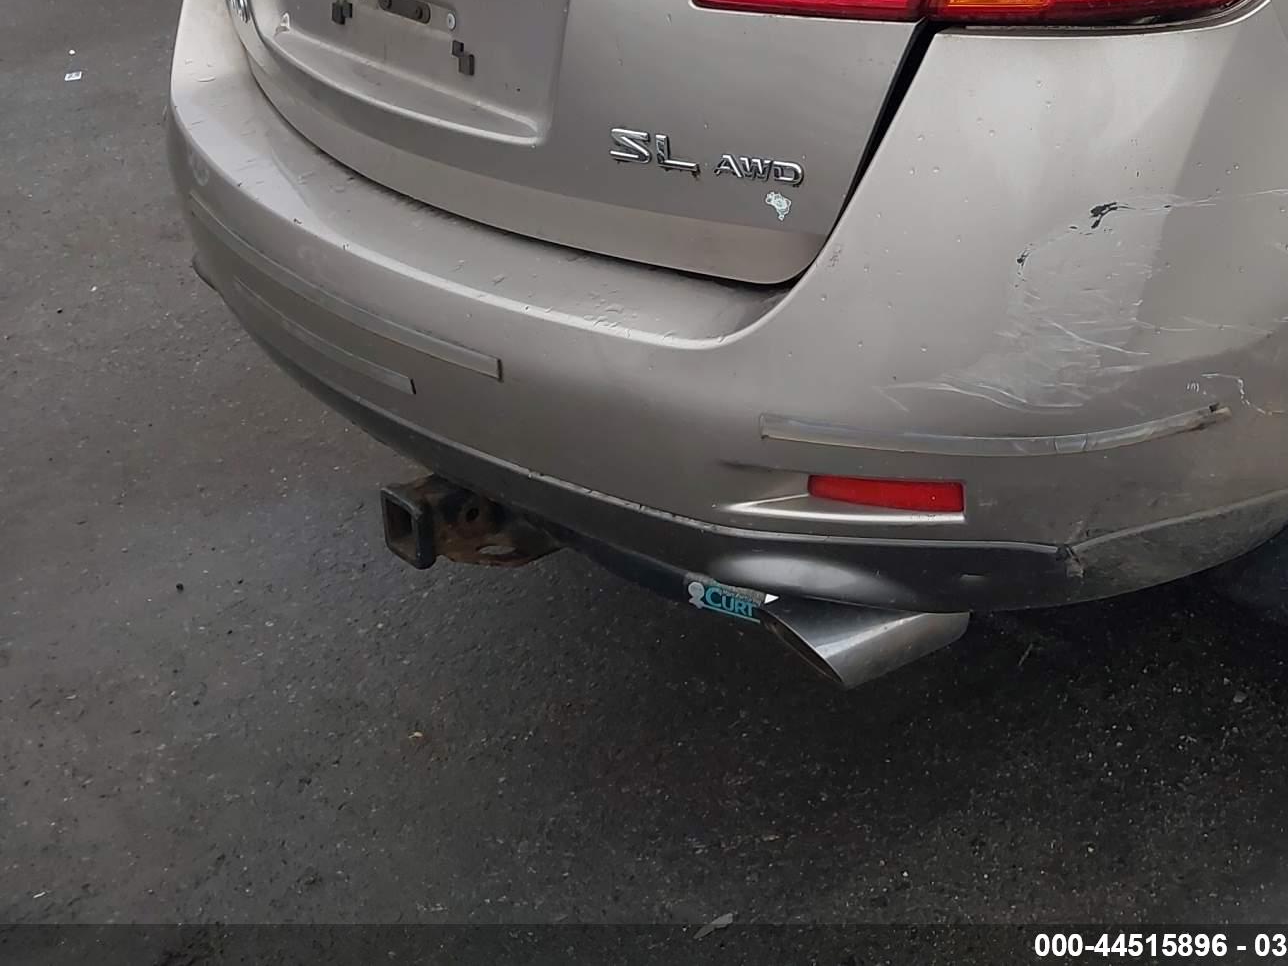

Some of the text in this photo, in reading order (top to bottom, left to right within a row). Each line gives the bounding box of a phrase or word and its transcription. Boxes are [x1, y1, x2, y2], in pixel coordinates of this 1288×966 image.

[610, 127, 804, 186] SL AWD
[705, 587, 753, 617] CURT
